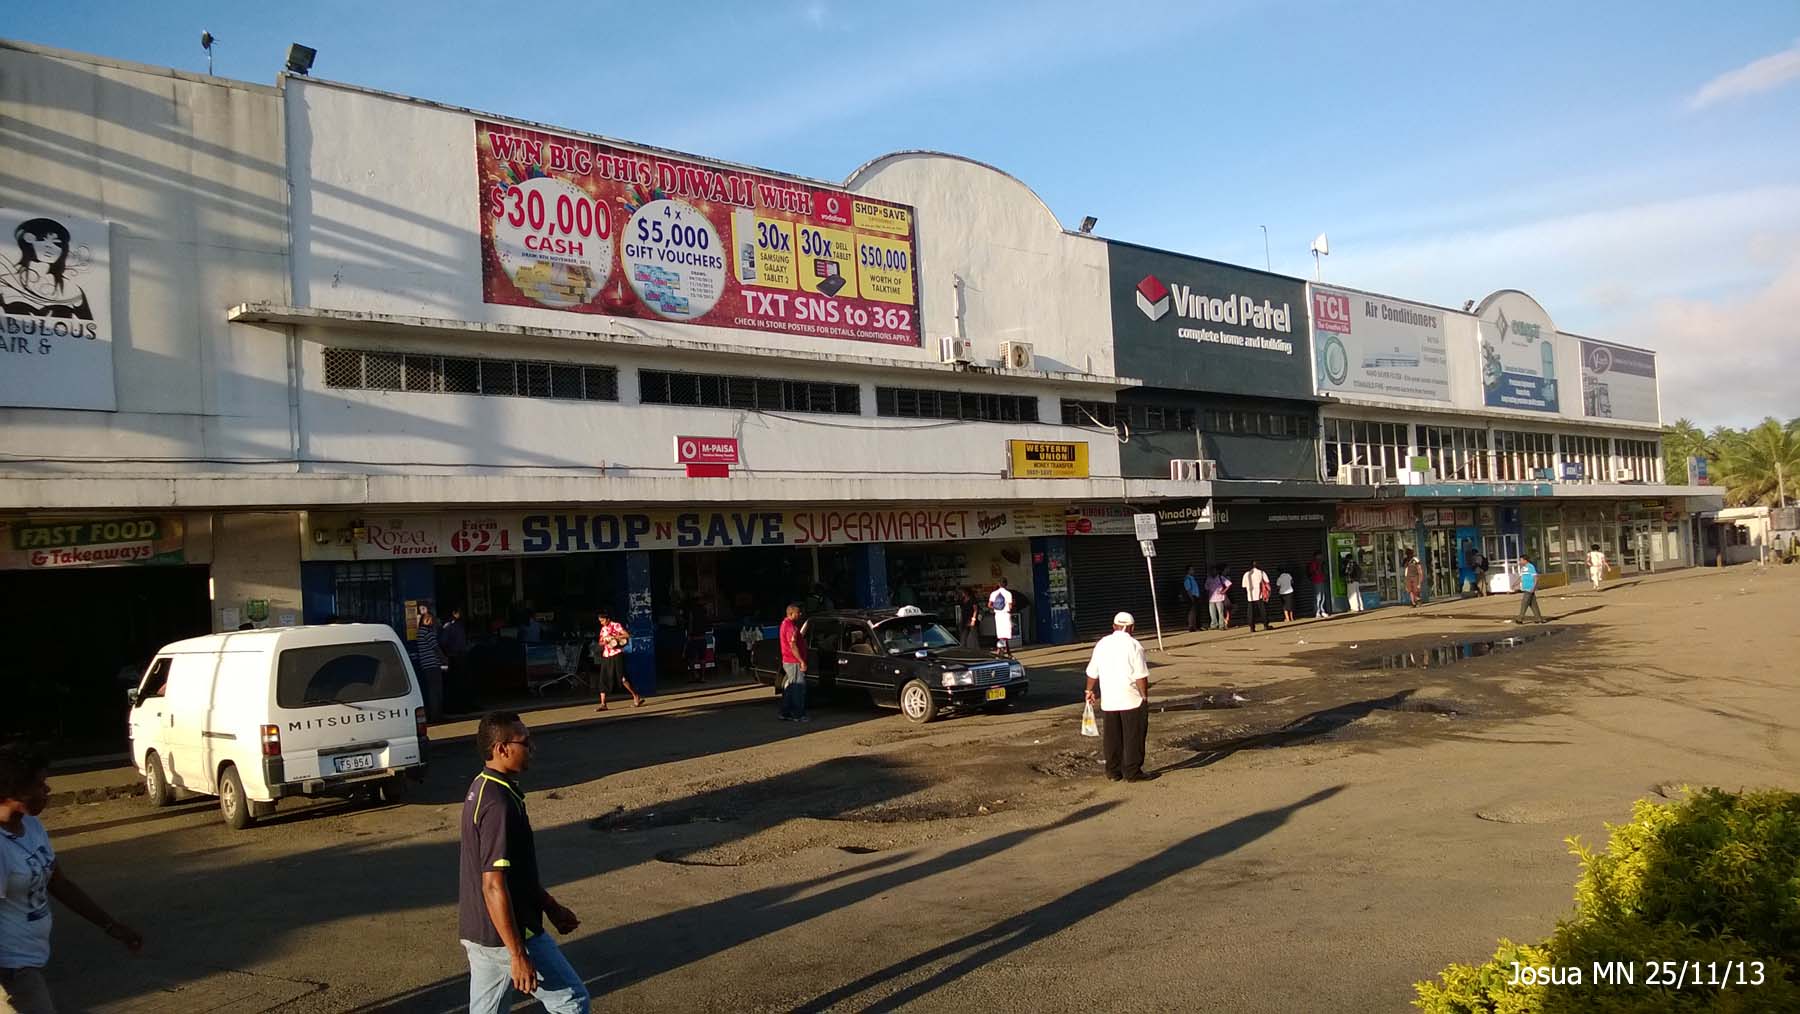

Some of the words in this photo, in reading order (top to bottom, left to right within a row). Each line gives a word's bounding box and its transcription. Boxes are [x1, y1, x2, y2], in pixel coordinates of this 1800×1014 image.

[488, 131, 542, 167] WIN
[549, 143, 593, 175] BIG
[596, 152, 652, 187] THIS
[656, 161, 757, 209] DIWALI
[758, 183, 812, 216] WITH
[490, 184, 612, 241] $30,000
[664, 205, 671, 219] 4
[820, 213, 847, 224] vodafone
[855, 203, 878, 216] SHOP
[883, 208, 906, 221] SAVE
[638, 216, 709, 250] $5,000
[757, 221, 790, 252] 30x
[801, 228, 832, 258] 30x
[524, 234, 584, 257] CASH
[625, 243, 653, 260] GIFT
[657, 247, 723, 270] VOUCHERS
[833, 251, 851, 260] TABLET
[835, 242, 848, 251] DELL
[760, 252, 790, 264] SAMSUNG
[764, 263, 787, 273] GALAXY
[860, 243, 907, 272] $50,000
[764, 273, 784, 283] TABLET
[870, 274, 894, 285] WORTH
[894, 277, 902, 285] OF
[871, 284, 901, 295] TALKTIME
[741, 290, 789, 317] TXT
[795, 297, 840, 323] SNS
[845, 304, 868, 326] to
[872, 306, 912, 331] 362
[1170, 283, 1238, 326] Vinod
[1240, 295, 1292, 333] Patel
[1316, 294, 1349, 320] TCL
[1365, 300, 1378, 318] Air
[1381, 303, 1438, 329] Conditioners
[734, 317, 756, 327] CHECK
[757, 319, 765, 328] IN
[765, 320, 787, 330] STORE
[787, 323, 816, 333] POSTERS
[816, 325, 829, 335] FOR
[829, 326, 855, 337] DETAILS.
[856, 329, 892, 340] CONDITIONS
[37, 339, 52, 355] &
[1178, 326, 1219, 344] complete
[1220, 330, 1243, 347] home
[1244, 333, 1260, 348] and
[1260, 335, 1293, 355] building
[702, 444, 734, 453] M-PAISA
[1026, 444, 1067, 453] WESTERN
[1158, 508, 1185, 520] Vinod
[1186, 505, 1210, 518] Patel
[20, 523, 81, 548] FAST
[90, 519, 157, 543] FOOD
[461, 519, 498, 530] Farm
[522, 514, 650, 553] SHOP
[654, 521, 672, 541] N
[676, 511, 784, 548] SAVE
[794, 510, 969, 544] SUPERMARKET
[392, 545, 438, 555] Harvest
[450, 528, 511, 553] 624
[31, 551, 49, 566] &
[50, 545, 150, 565] Takeaways
[288, 708, 409, 732] MITSUBISHI
